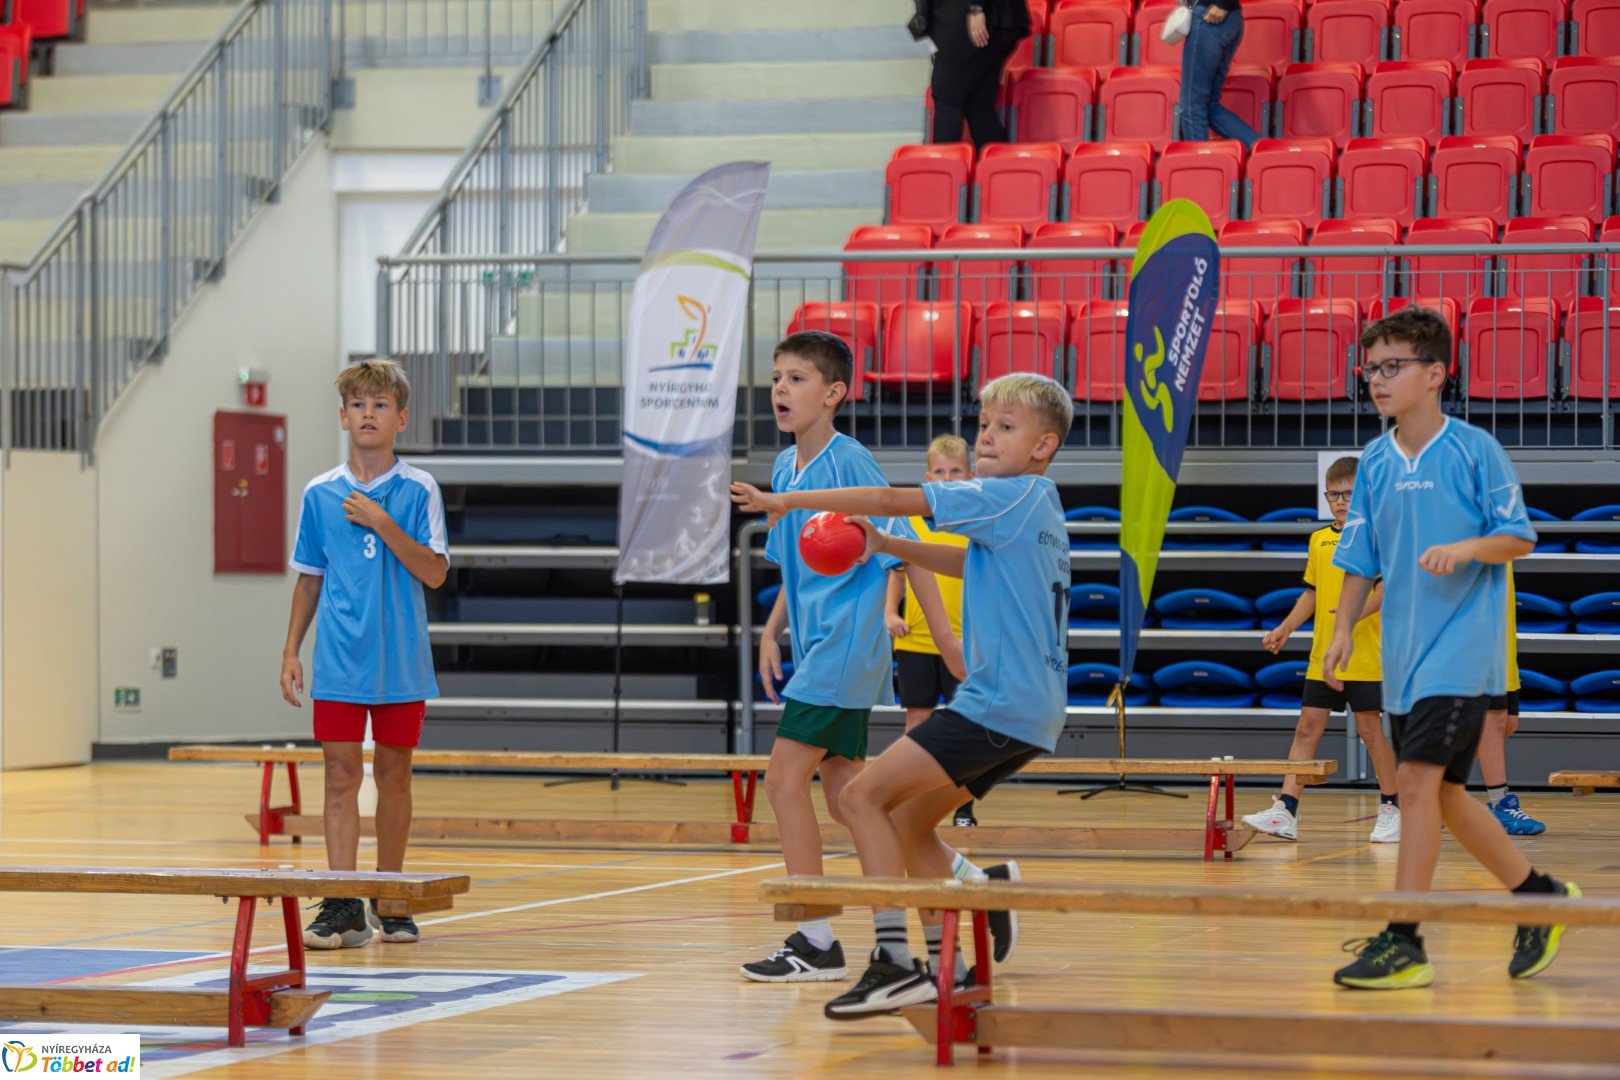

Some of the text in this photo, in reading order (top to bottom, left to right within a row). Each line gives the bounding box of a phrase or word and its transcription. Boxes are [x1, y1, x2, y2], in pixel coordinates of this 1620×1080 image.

[1168, 256, 1208, 367] SPORTOLÓ
[1174, 306, 1205, 392] NEMZET
[363, 533, 377, 559] 3
